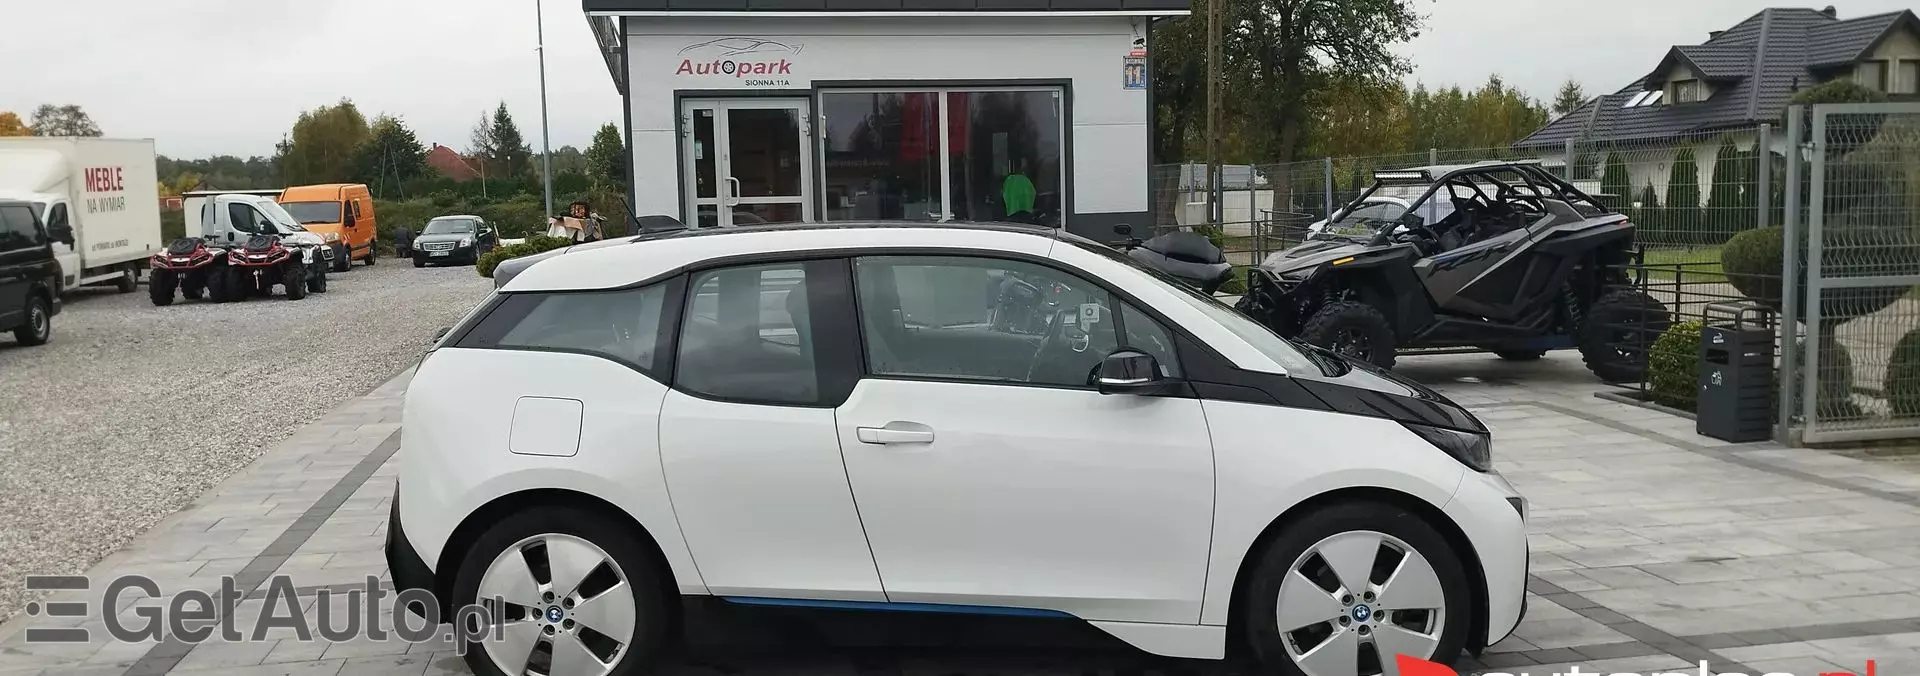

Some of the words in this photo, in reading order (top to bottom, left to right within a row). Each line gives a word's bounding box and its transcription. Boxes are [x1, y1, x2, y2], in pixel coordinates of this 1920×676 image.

[676, 59, 792, 78] Autopark
[85, 167, 124, 192] MEBLE
[87, 198, 97, 214] NA
[98, 196, 126, 213] WYMIAR
